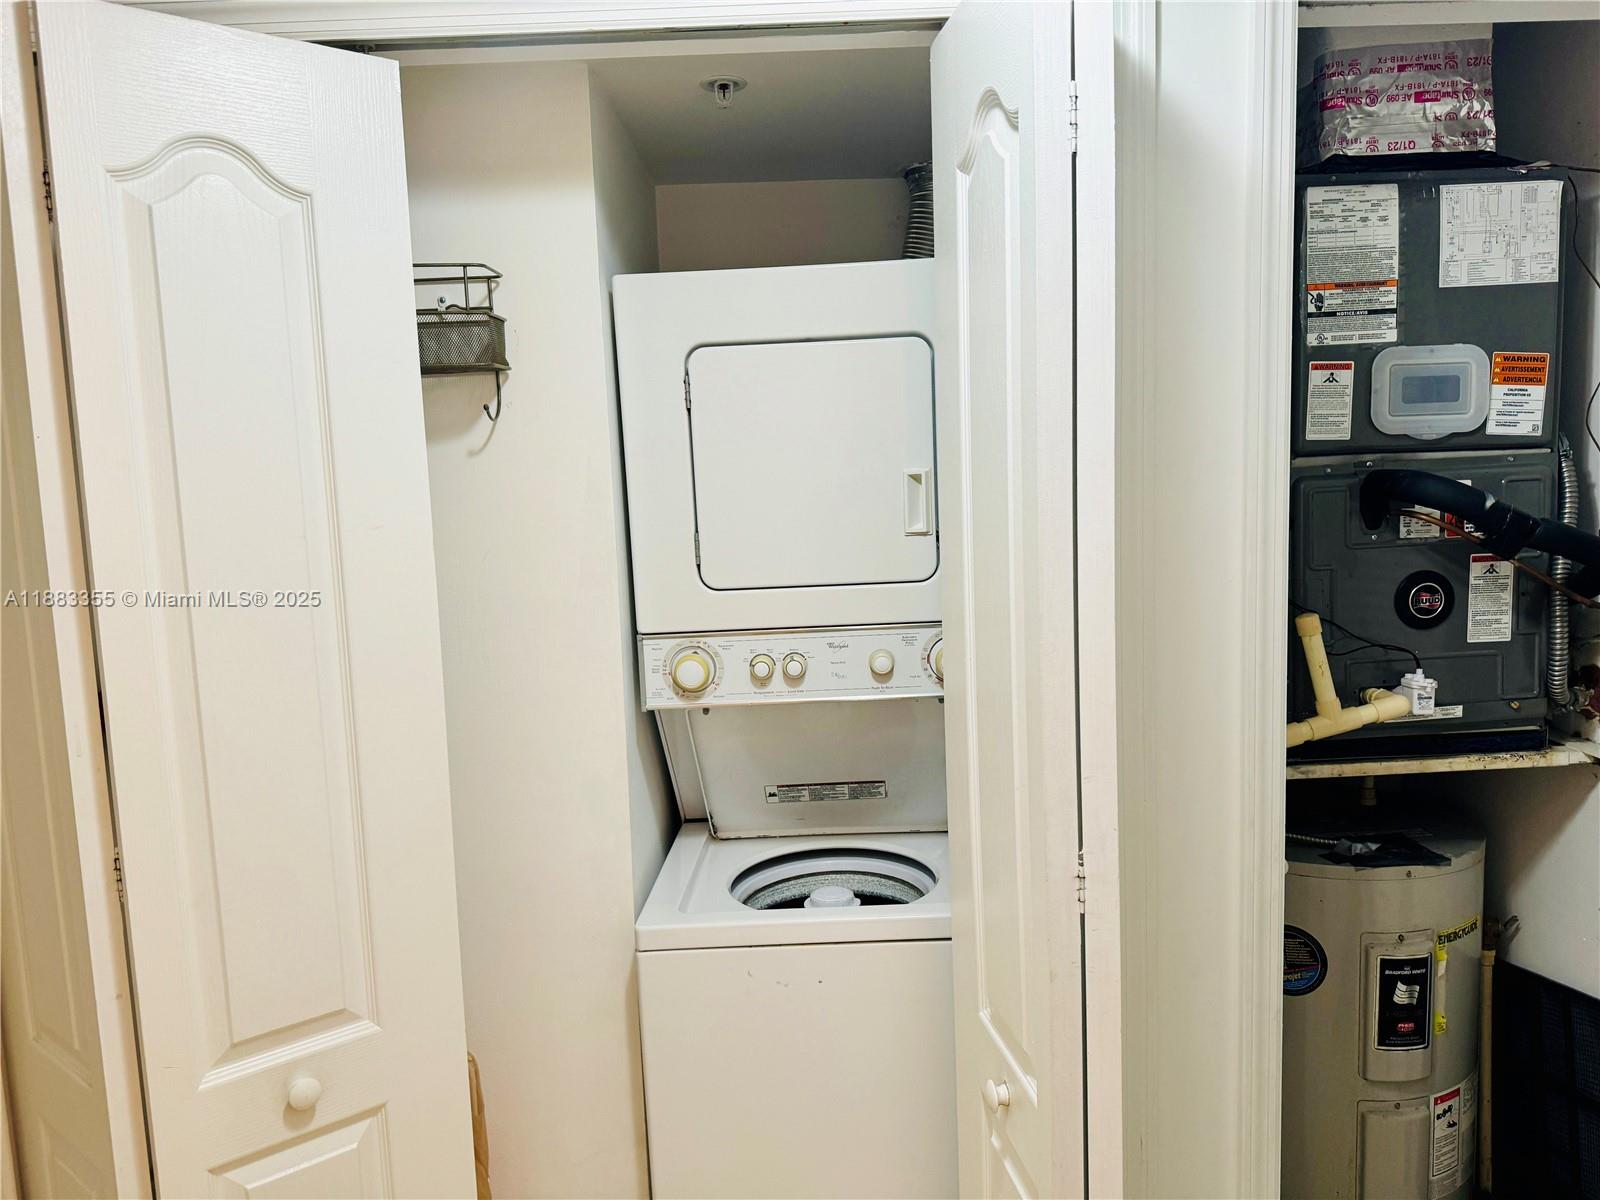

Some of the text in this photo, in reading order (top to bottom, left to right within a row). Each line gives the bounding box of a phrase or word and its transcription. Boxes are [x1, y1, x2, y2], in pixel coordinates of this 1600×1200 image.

[1395, 82, 1425, 91] 181B-FX
[1386, 95, 1401, 103] 099
[1423, 90, 1460, 100] Shurtape
[1388, 140, 1416, 151] Q1/23
[1413, 596, 1440, 606] RUUD
